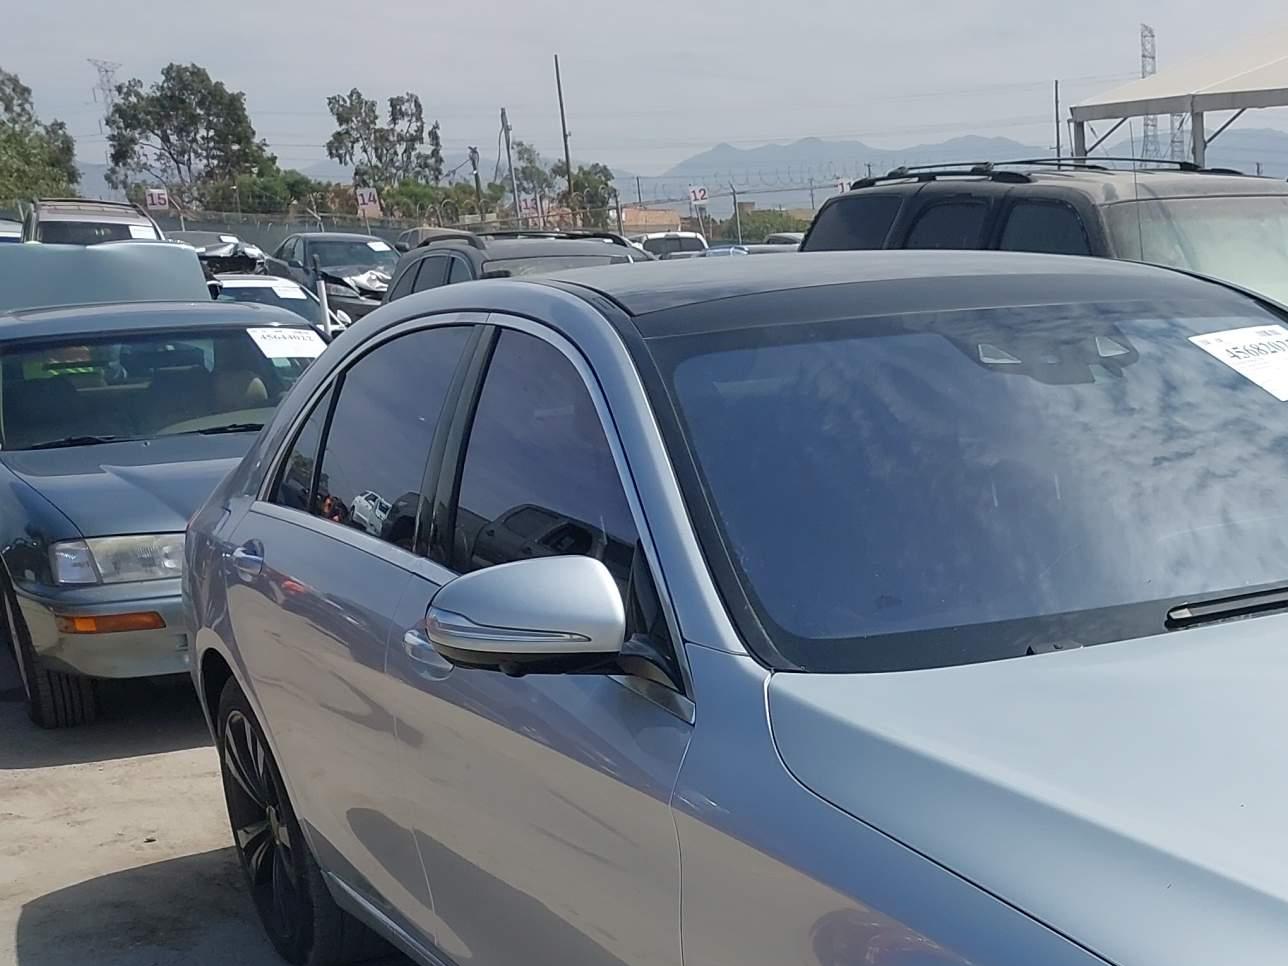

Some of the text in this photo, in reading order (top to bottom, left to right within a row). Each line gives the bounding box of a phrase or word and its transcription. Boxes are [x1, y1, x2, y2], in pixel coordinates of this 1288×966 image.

[147, 192, 167, 206] 15
[359, 192, 377, 206] 14
[691, 188, 708, 201] 12
